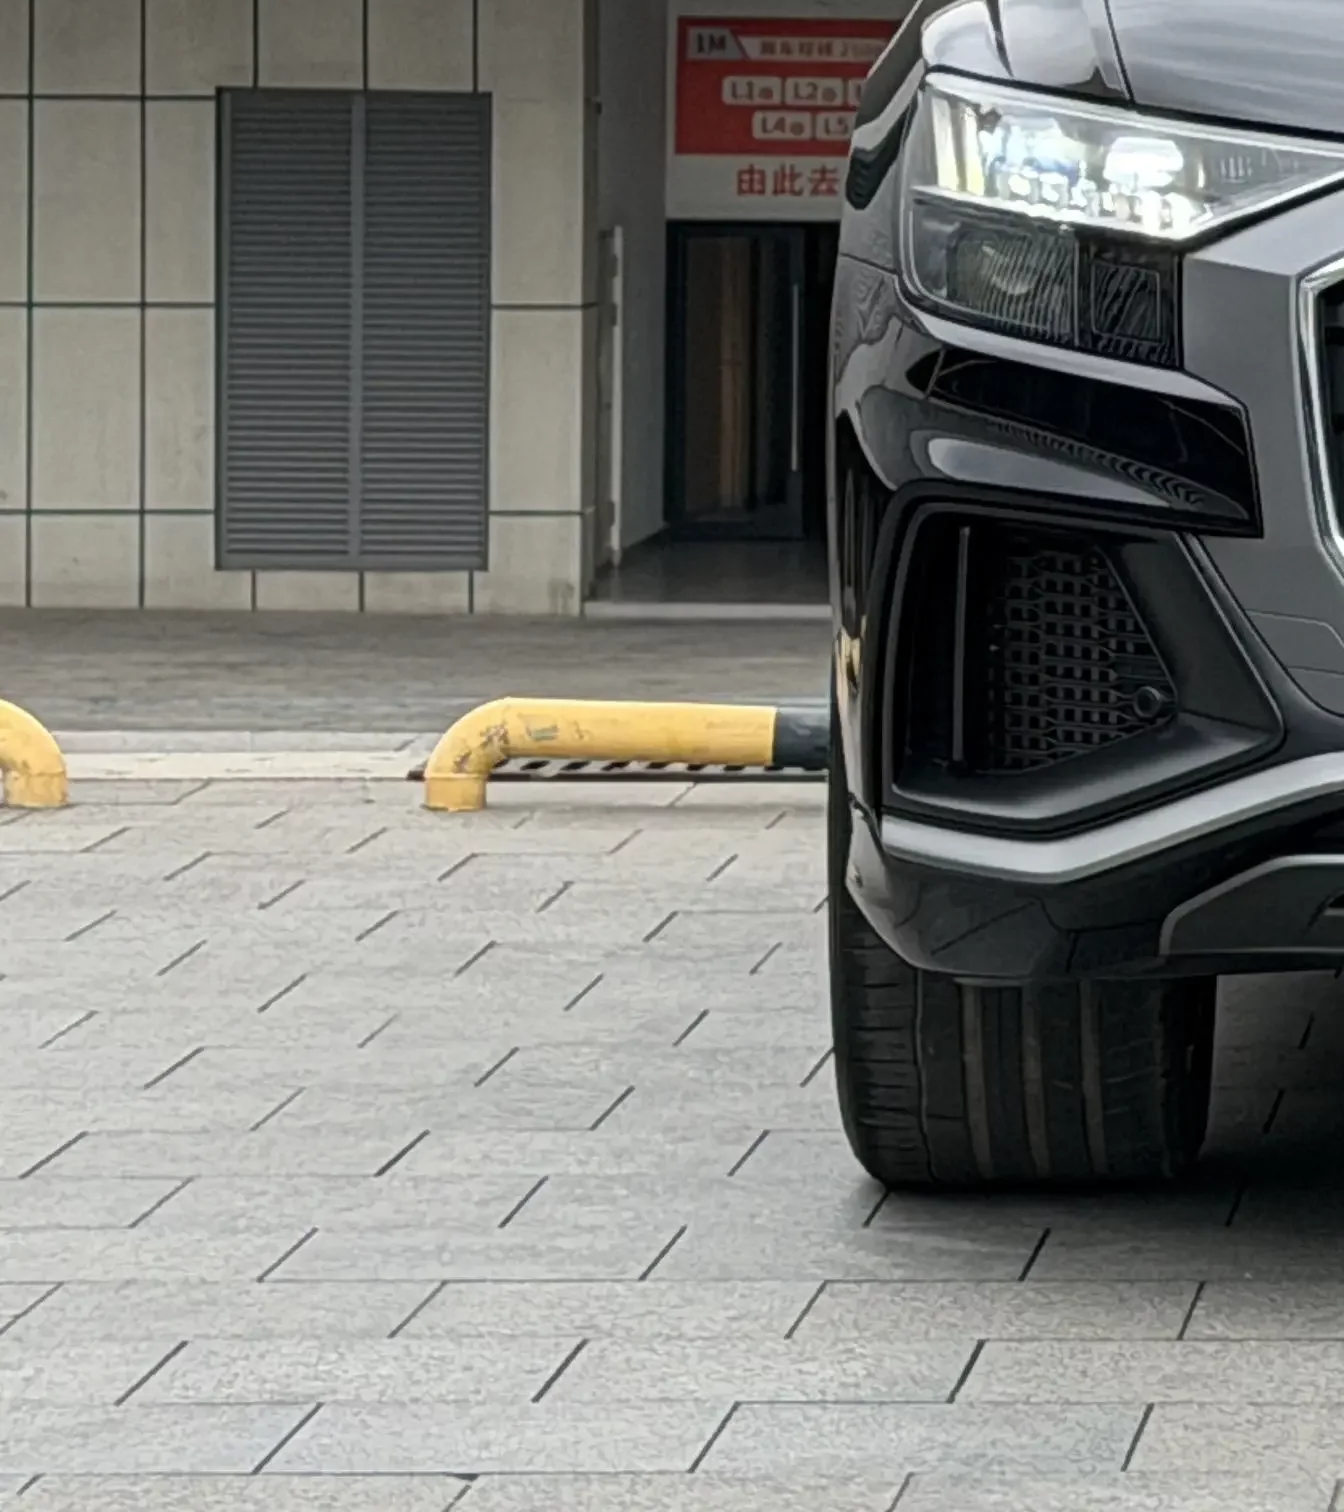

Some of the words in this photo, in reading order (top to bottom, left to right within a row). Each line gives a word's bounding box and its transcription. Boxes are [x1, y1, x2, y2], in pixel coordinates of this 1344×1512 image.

[793, 81, 818, 100] L2
[761, 116, 786, 135] L4
[736, 163, 840, 197] 由此去
